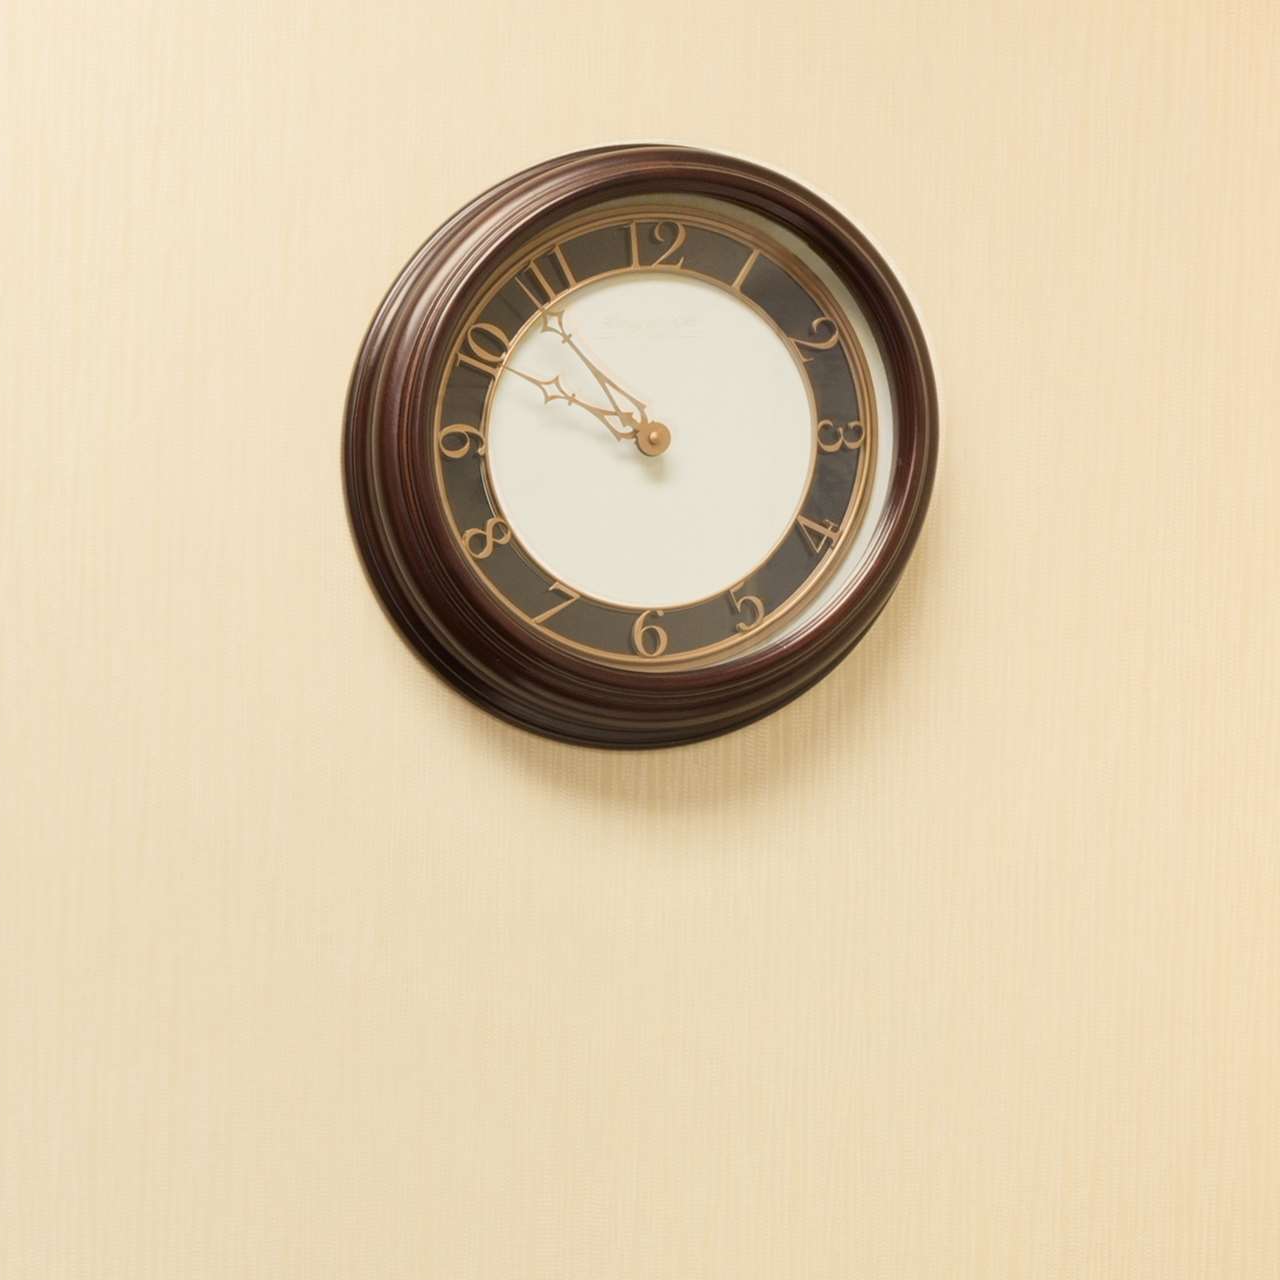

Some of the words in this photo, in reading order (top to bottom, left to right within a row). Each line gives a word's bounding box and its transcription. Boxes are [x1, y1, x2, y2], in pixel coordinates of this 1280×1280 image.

[628, 220, 687, 269] 12
[732, 249, 761, 291] 1
[455, 322, 512, 376] 10
[790, 316, 840, 363] 2
[440, 423, 486, 459] 9
[816, 419, 864, 452] 3
[462, 516, 511, 560] 8
[796, 514, 842, 553] 4
[532, 582, 581, 624] 7
[729, 582, 765, 632] 5
[632, 609, 668, 658] 6
